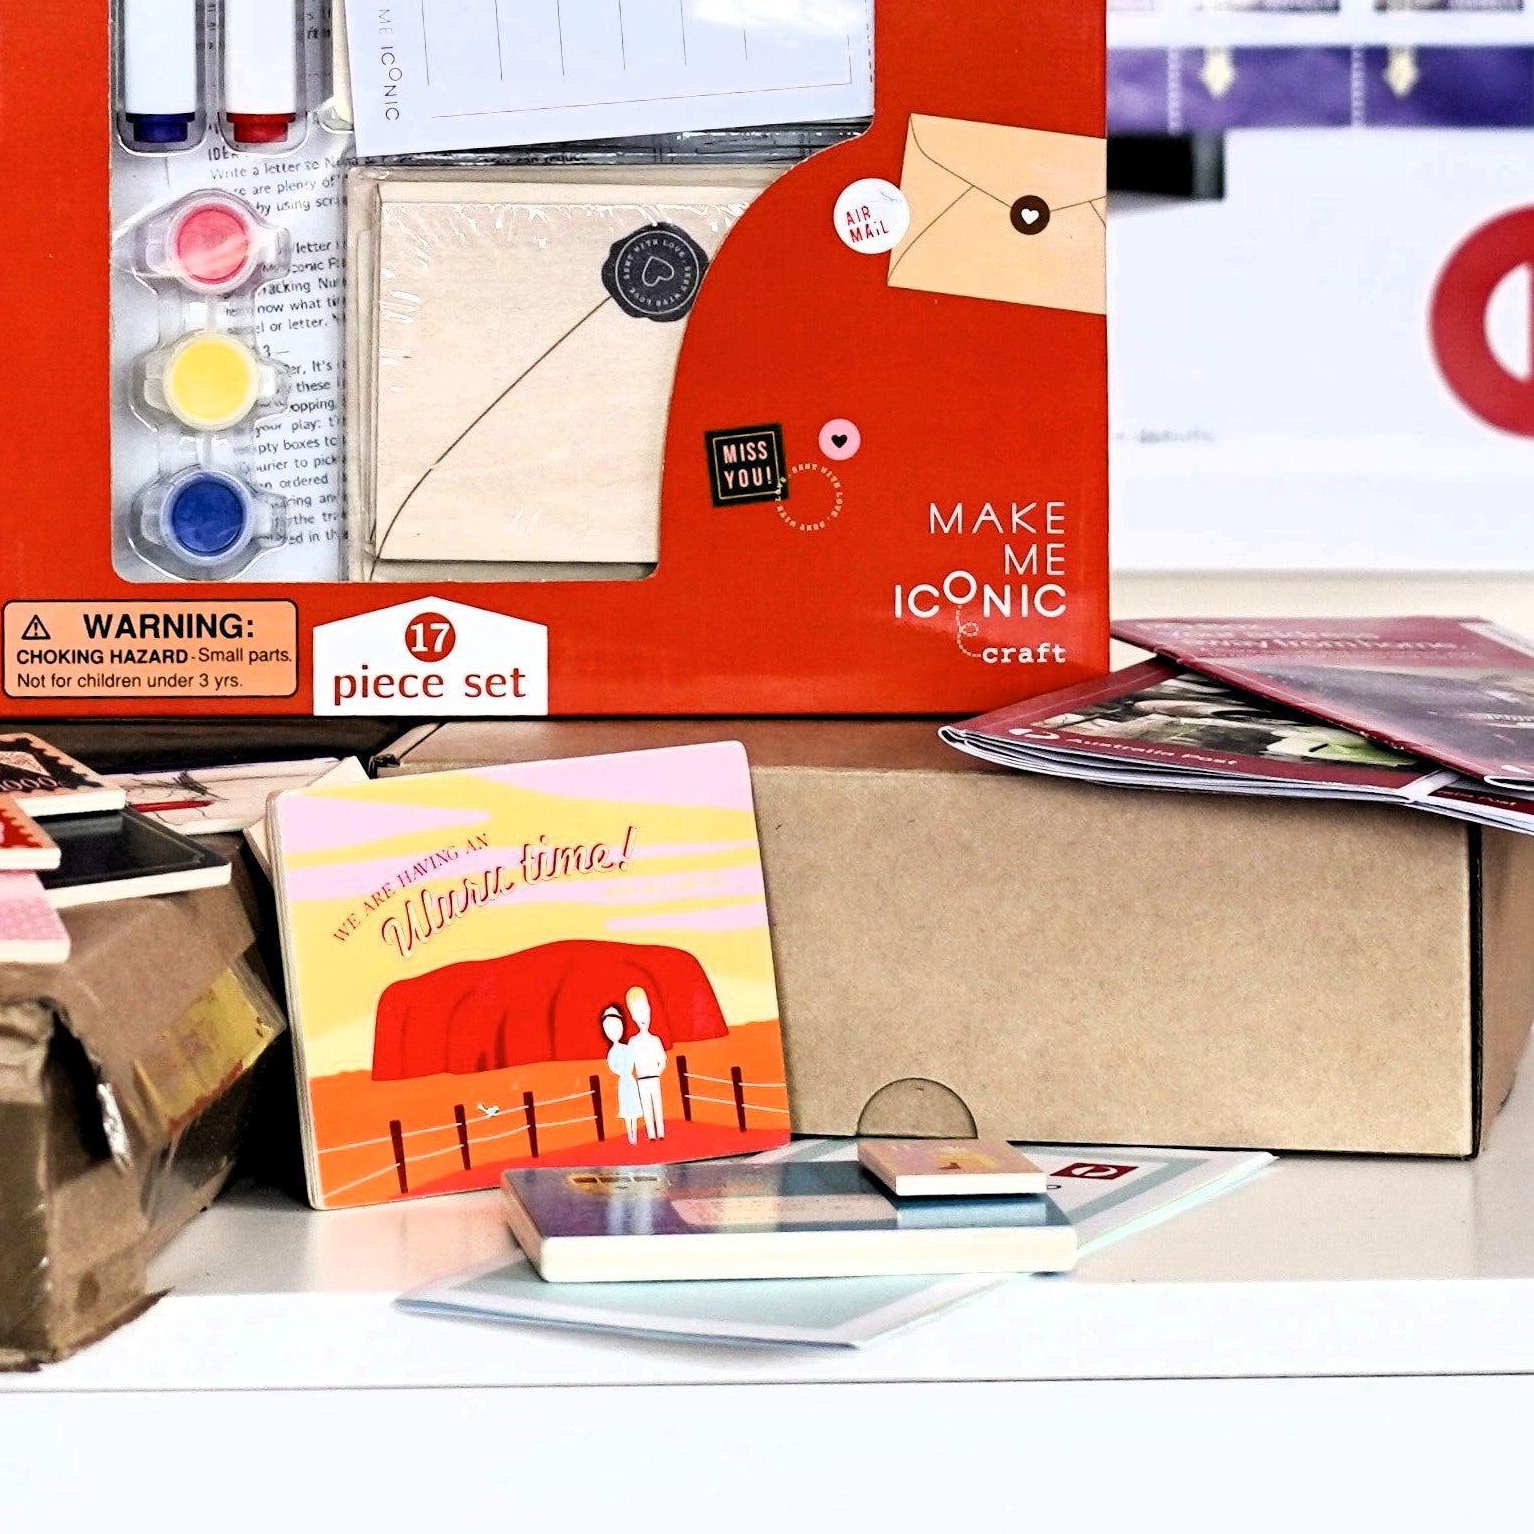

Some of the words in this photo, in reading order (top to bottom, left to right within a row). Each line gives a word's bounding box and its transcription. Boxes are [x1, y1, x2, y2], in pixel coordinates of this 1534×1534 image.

[378, 9, 394, 35] ME
[381, 46, 403, 122] ICONIC
[265, 160, 300, 175] letter
[277, 198, 311, 212] using
[846, 206, 871, 227] AIR
[289, 298, 322, 311] what
[269, 322, 283, 332] or
[288, 317, 329, 331] letter.
[311, 360, 334, 373] It's
[296, 380, 331, 393] these
[283, 438, 320, 451] boxes
[722, 440, 769, 465] MISS
[294, 458, 308, 469] to
[279, 473, 330, 489] ordered
[724, 465, 773, 490] YOU!
[929, 501, 1066, 535] MAKE
[1004, 543, 1066, 576] ME
[895, 571, 1067, 618] ICONIC
[83, 613, 255, 640] WARNING:
[410, 622, 451, 654] 17
[17, 648, 104, 665] CHOKING
[110, 648, 188, 665] HAZARD
[249, 647, 293, 667] parts.
[982, 641, 1067, 665] craft
[17, 673, 46, 689] Not
[51, 672, 72, 688] for
[77, 672, 142, 689] children
[147, 672, 193, 688] under
[199, 673, 210, 688] 3
[214, 674, 243, 692] yrs.
[333, 663, 445, 706] piece
[464, 667, 526, 698] set
[1066, 738, 1175, 758] Australia
[1181, 752, 1239, 766] Post
[332, 912, 360, 945] WE
[360, 882, 396, 917] ARE
[397, 843, 461, 890] HAVING
[464, 831, 490, 855] AN
[380, 866, 517, 960] Uluru
[520, 825, 640, 888] time!
